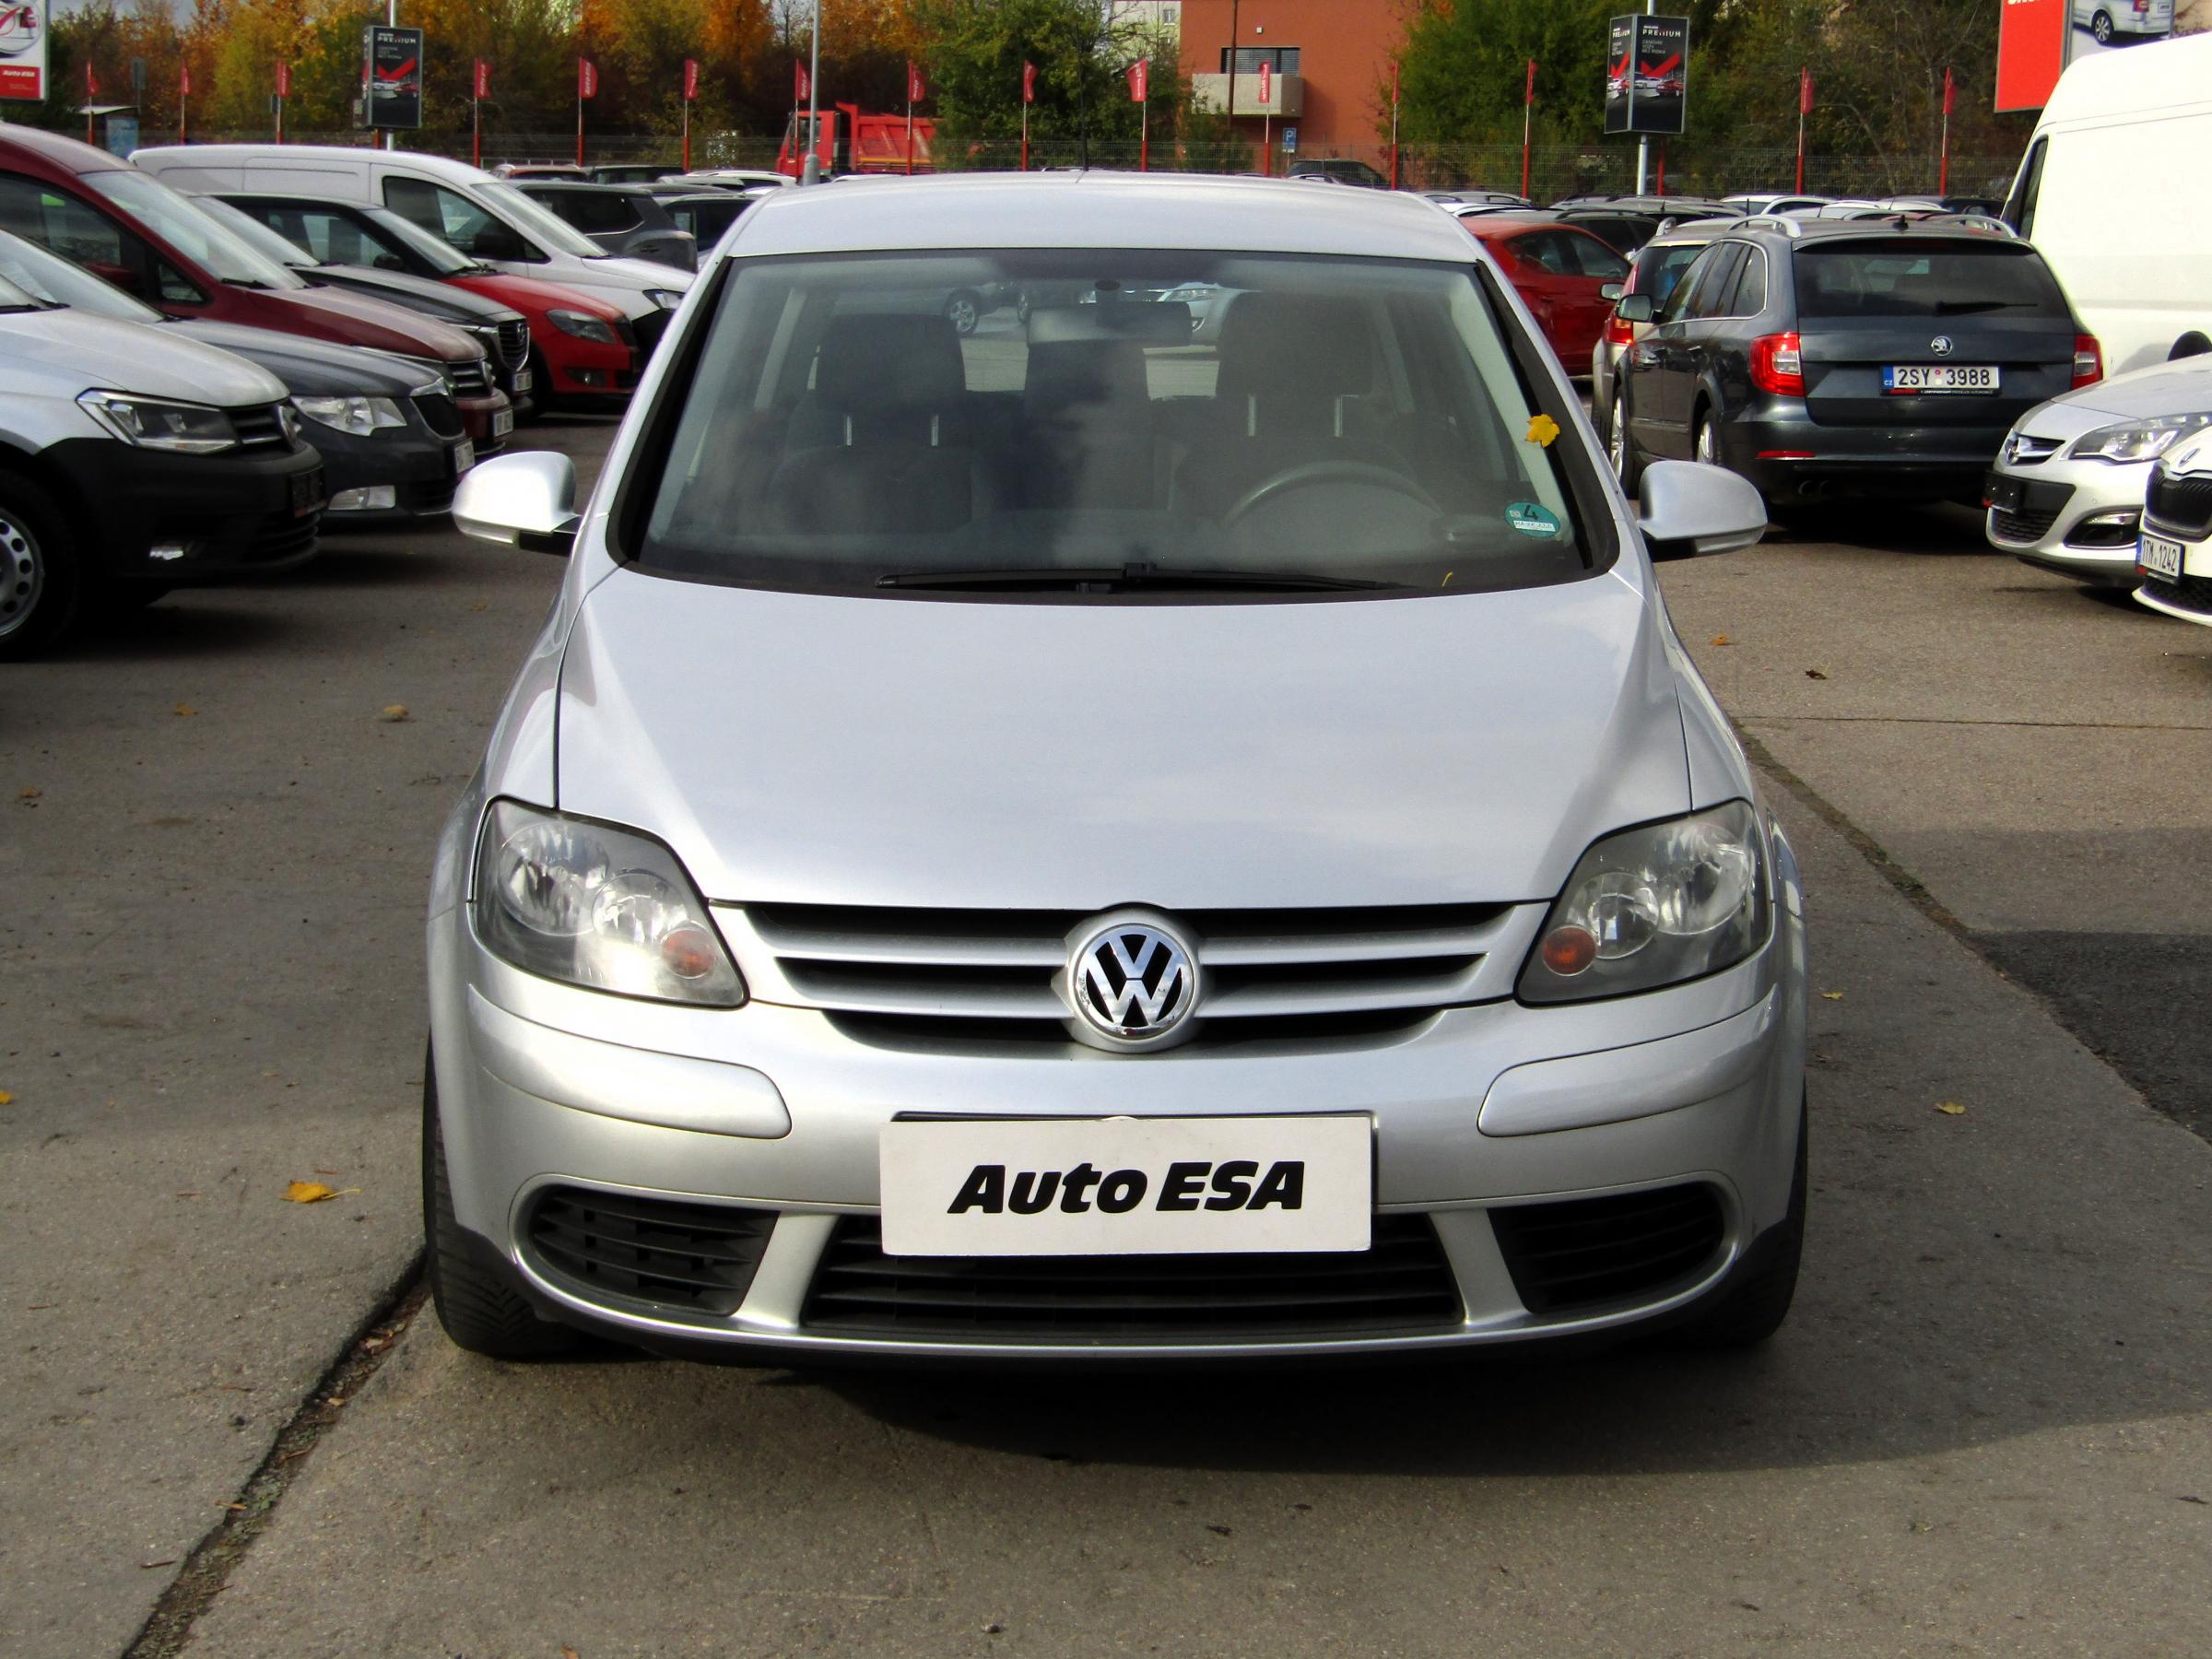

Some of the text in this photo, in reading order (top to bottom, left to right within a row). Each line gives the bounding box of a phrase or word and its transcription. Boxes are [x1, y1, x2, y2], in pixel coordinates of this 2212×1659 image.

[1286, 130, 1293, 141] P
[1898, 369, 1991, 385] 2SY 3988
[2159, 545, 2177, 571] 1242
[947, 1160, 1305, 1215] Auto ESA
